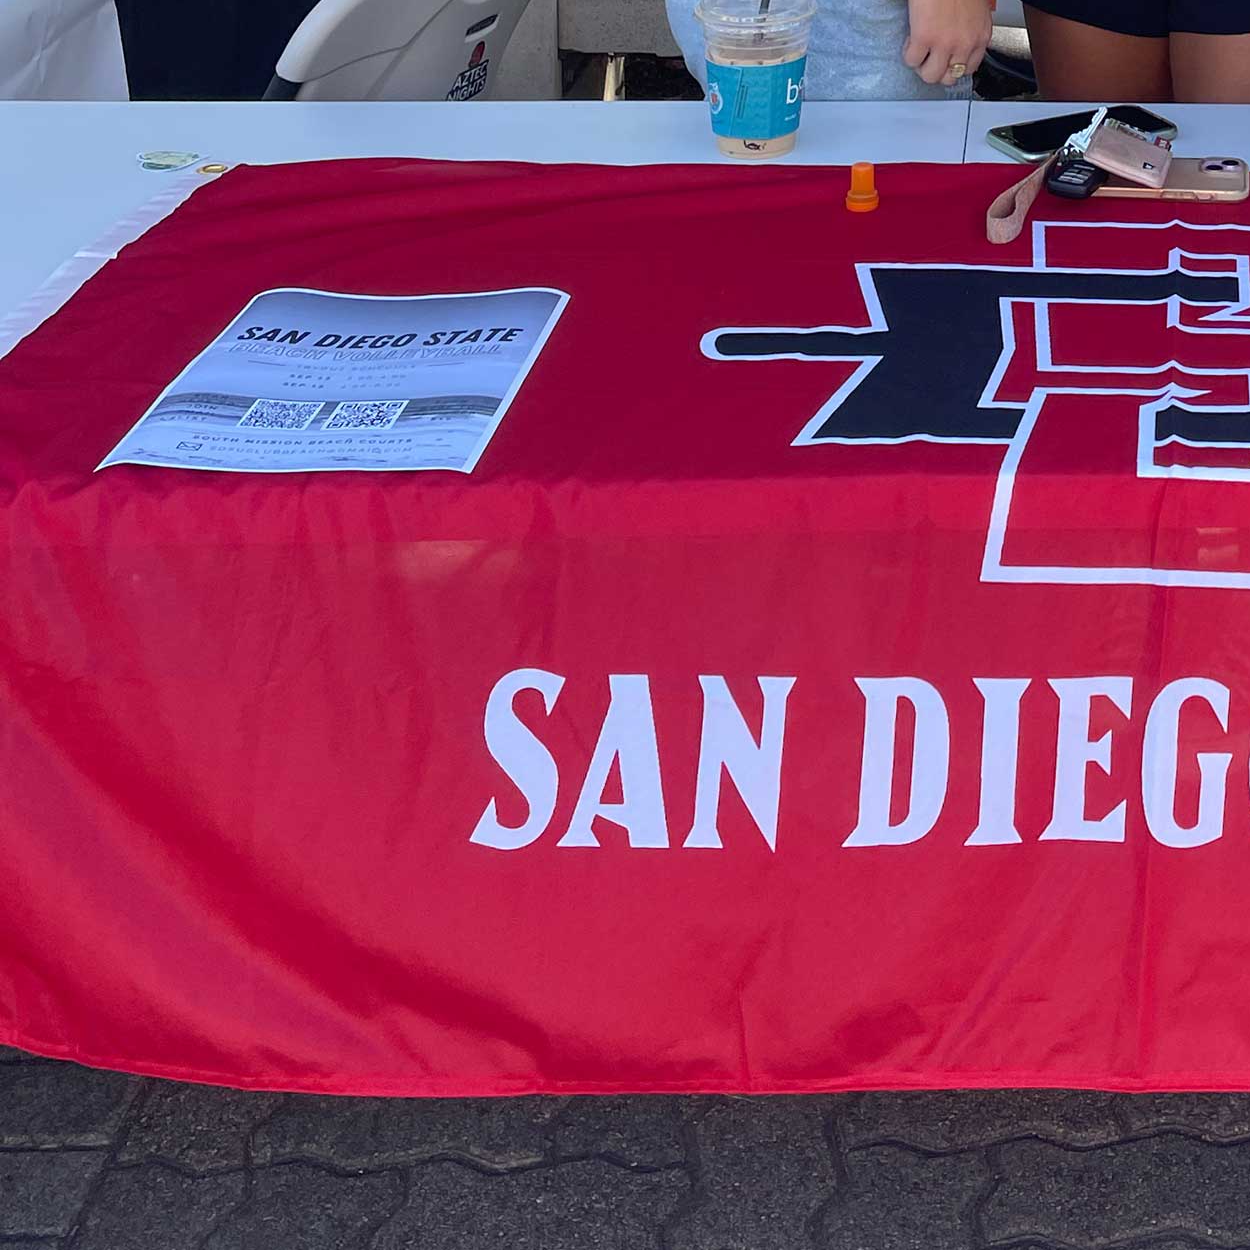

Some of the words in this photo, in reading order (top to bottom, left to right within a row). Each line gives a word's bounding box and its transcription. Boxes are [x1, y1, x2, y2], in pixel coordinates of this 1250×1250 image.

[237, 326, 311, 345] SAN
[313, 333, 418, 349] DIEGO
[422, 328, 524, 346] STATE
[228, 343, 328, 360] BEACH
[332, 344, 503, 362] VOLLEYBALL
[469, 667, 796, 852] SAN
